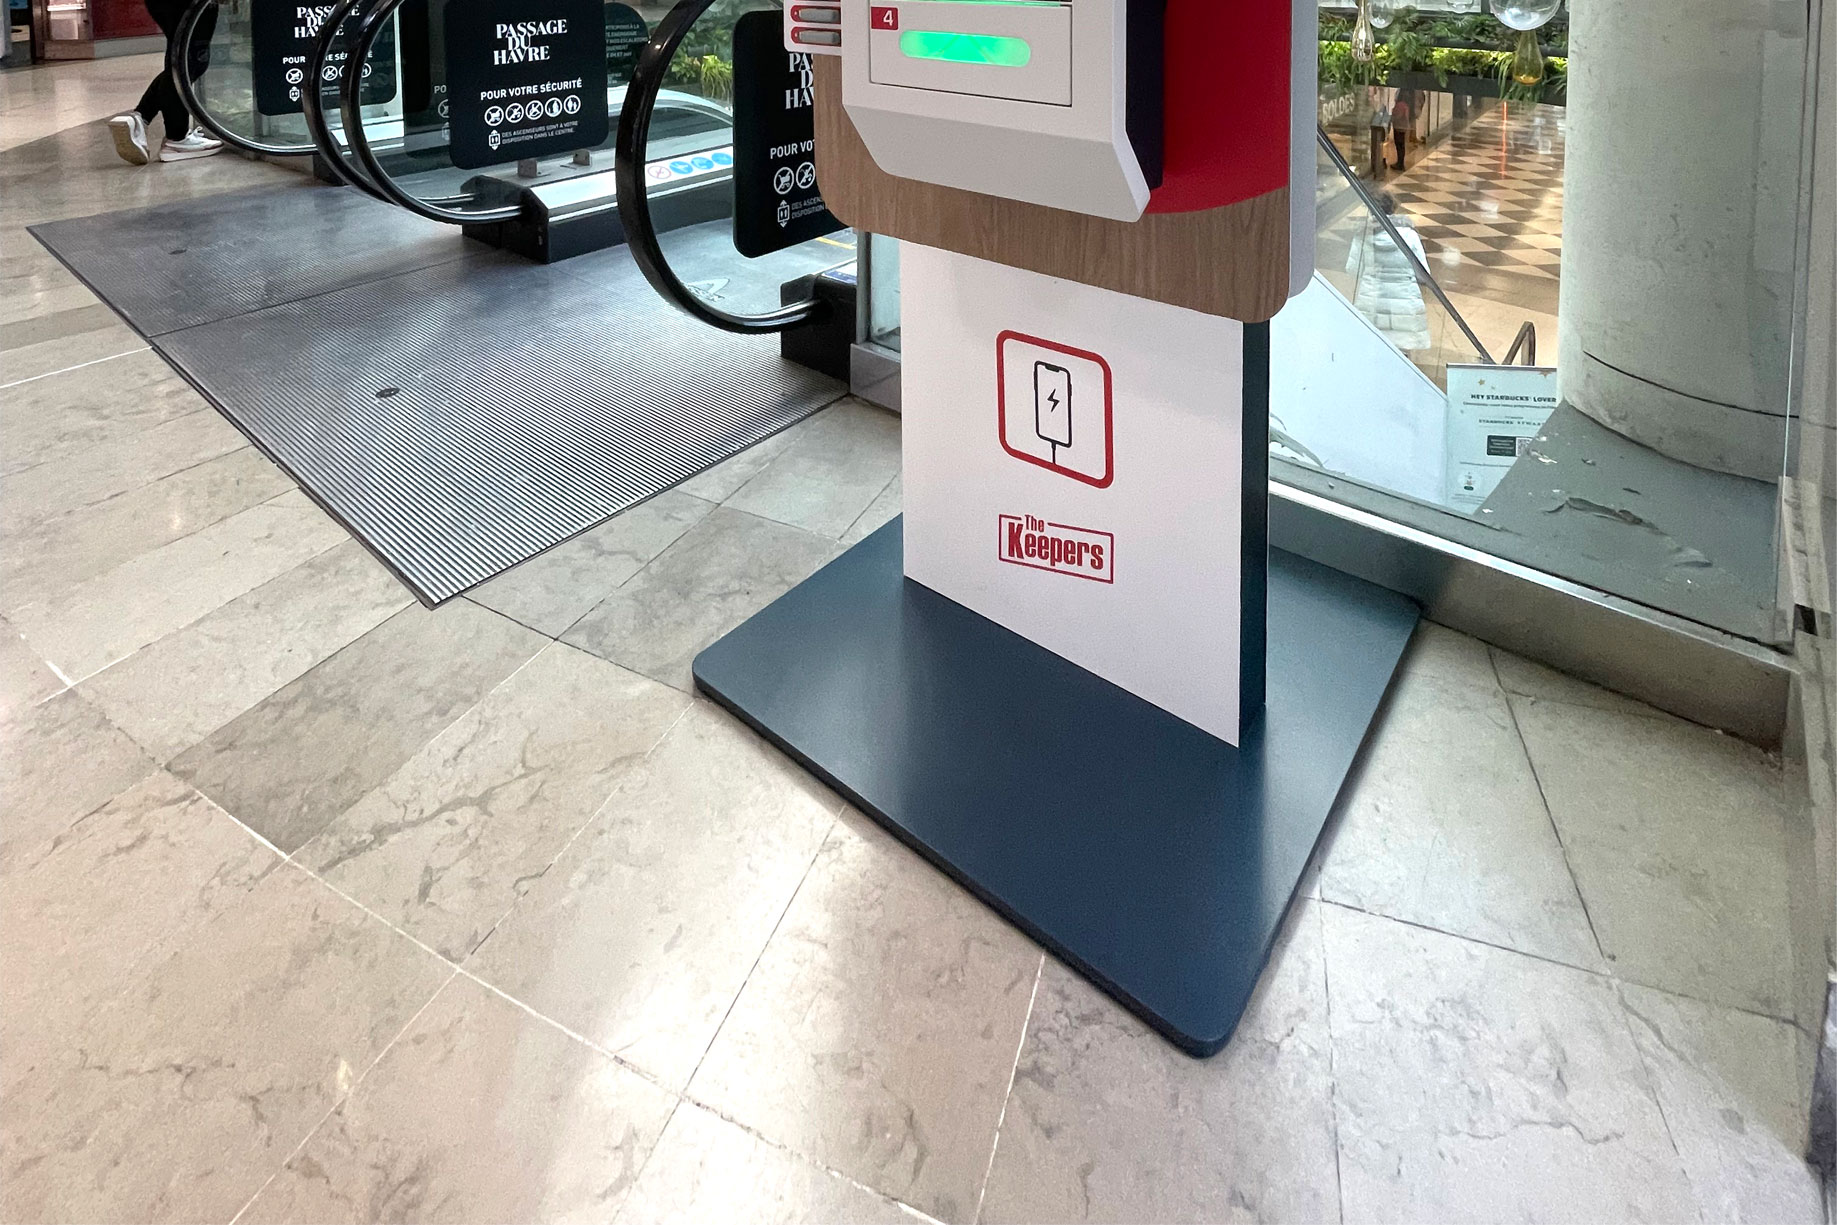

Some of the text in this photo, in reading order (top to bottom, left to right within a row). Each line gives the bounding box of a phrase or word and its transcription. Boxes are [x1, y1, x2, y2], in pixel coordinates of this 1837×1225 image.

[296, 5, 360, 19] PASSE
[882, 10, 894, 26] 4
[496, 19, 568, 39] PASSAGE
[508, 34, 531, 50] DU
[282, 56, 306, 64] POUR
[493, 46, 551, 65] HAVRE
[434, 85, 447, 94] PO
[480, 77, 583, 101] POUR VOTRE SÉCURITÉ
[1322, 92, 1355, 126] SOLDES
[770, 140, 798, 160] POUR
[803, 196, 824, 206] ASCEN
[791, 204, 825, 219] DISPOSITION
[1024, 514, 1045, 533] The
[1008, 521, 1104, 570] Keepers
